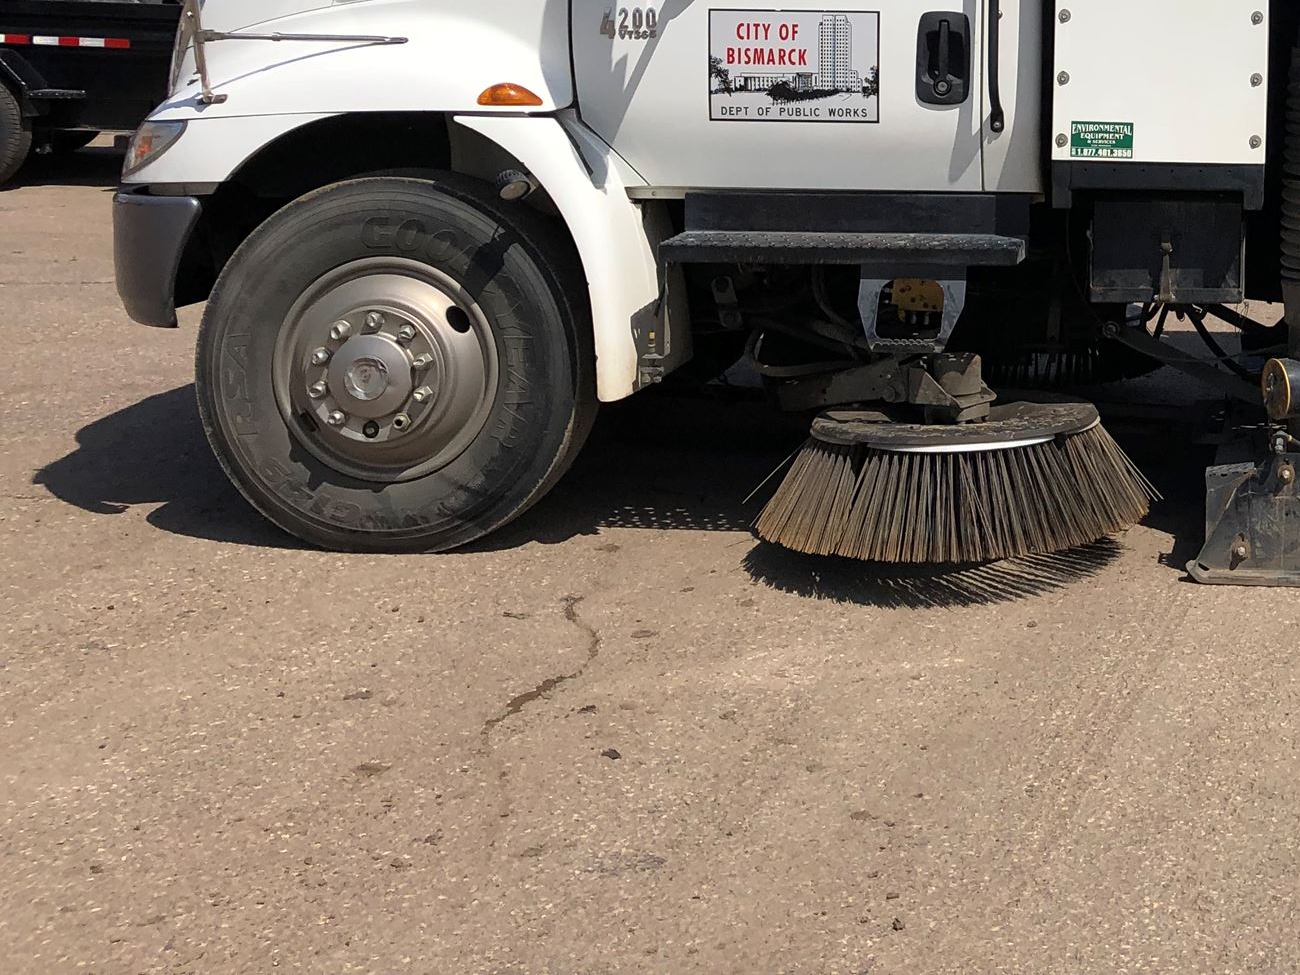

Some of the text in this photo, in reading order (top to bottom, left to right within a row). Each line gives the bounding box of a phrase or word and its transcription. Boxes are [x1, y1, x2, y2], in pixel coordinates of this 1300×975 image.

[600, 6, 657, 40] 4200
[736, 23, 799, 41] CITY OF
[727, 48, 808, 66] BISMARCK
[721, 106, 868, 117] DEPT OF PUBLIC WORKS
[1072, 123, 1132, 135] ENVIRONMENTAL
[1080, 132, 1124, 140] EQUIPMENT
